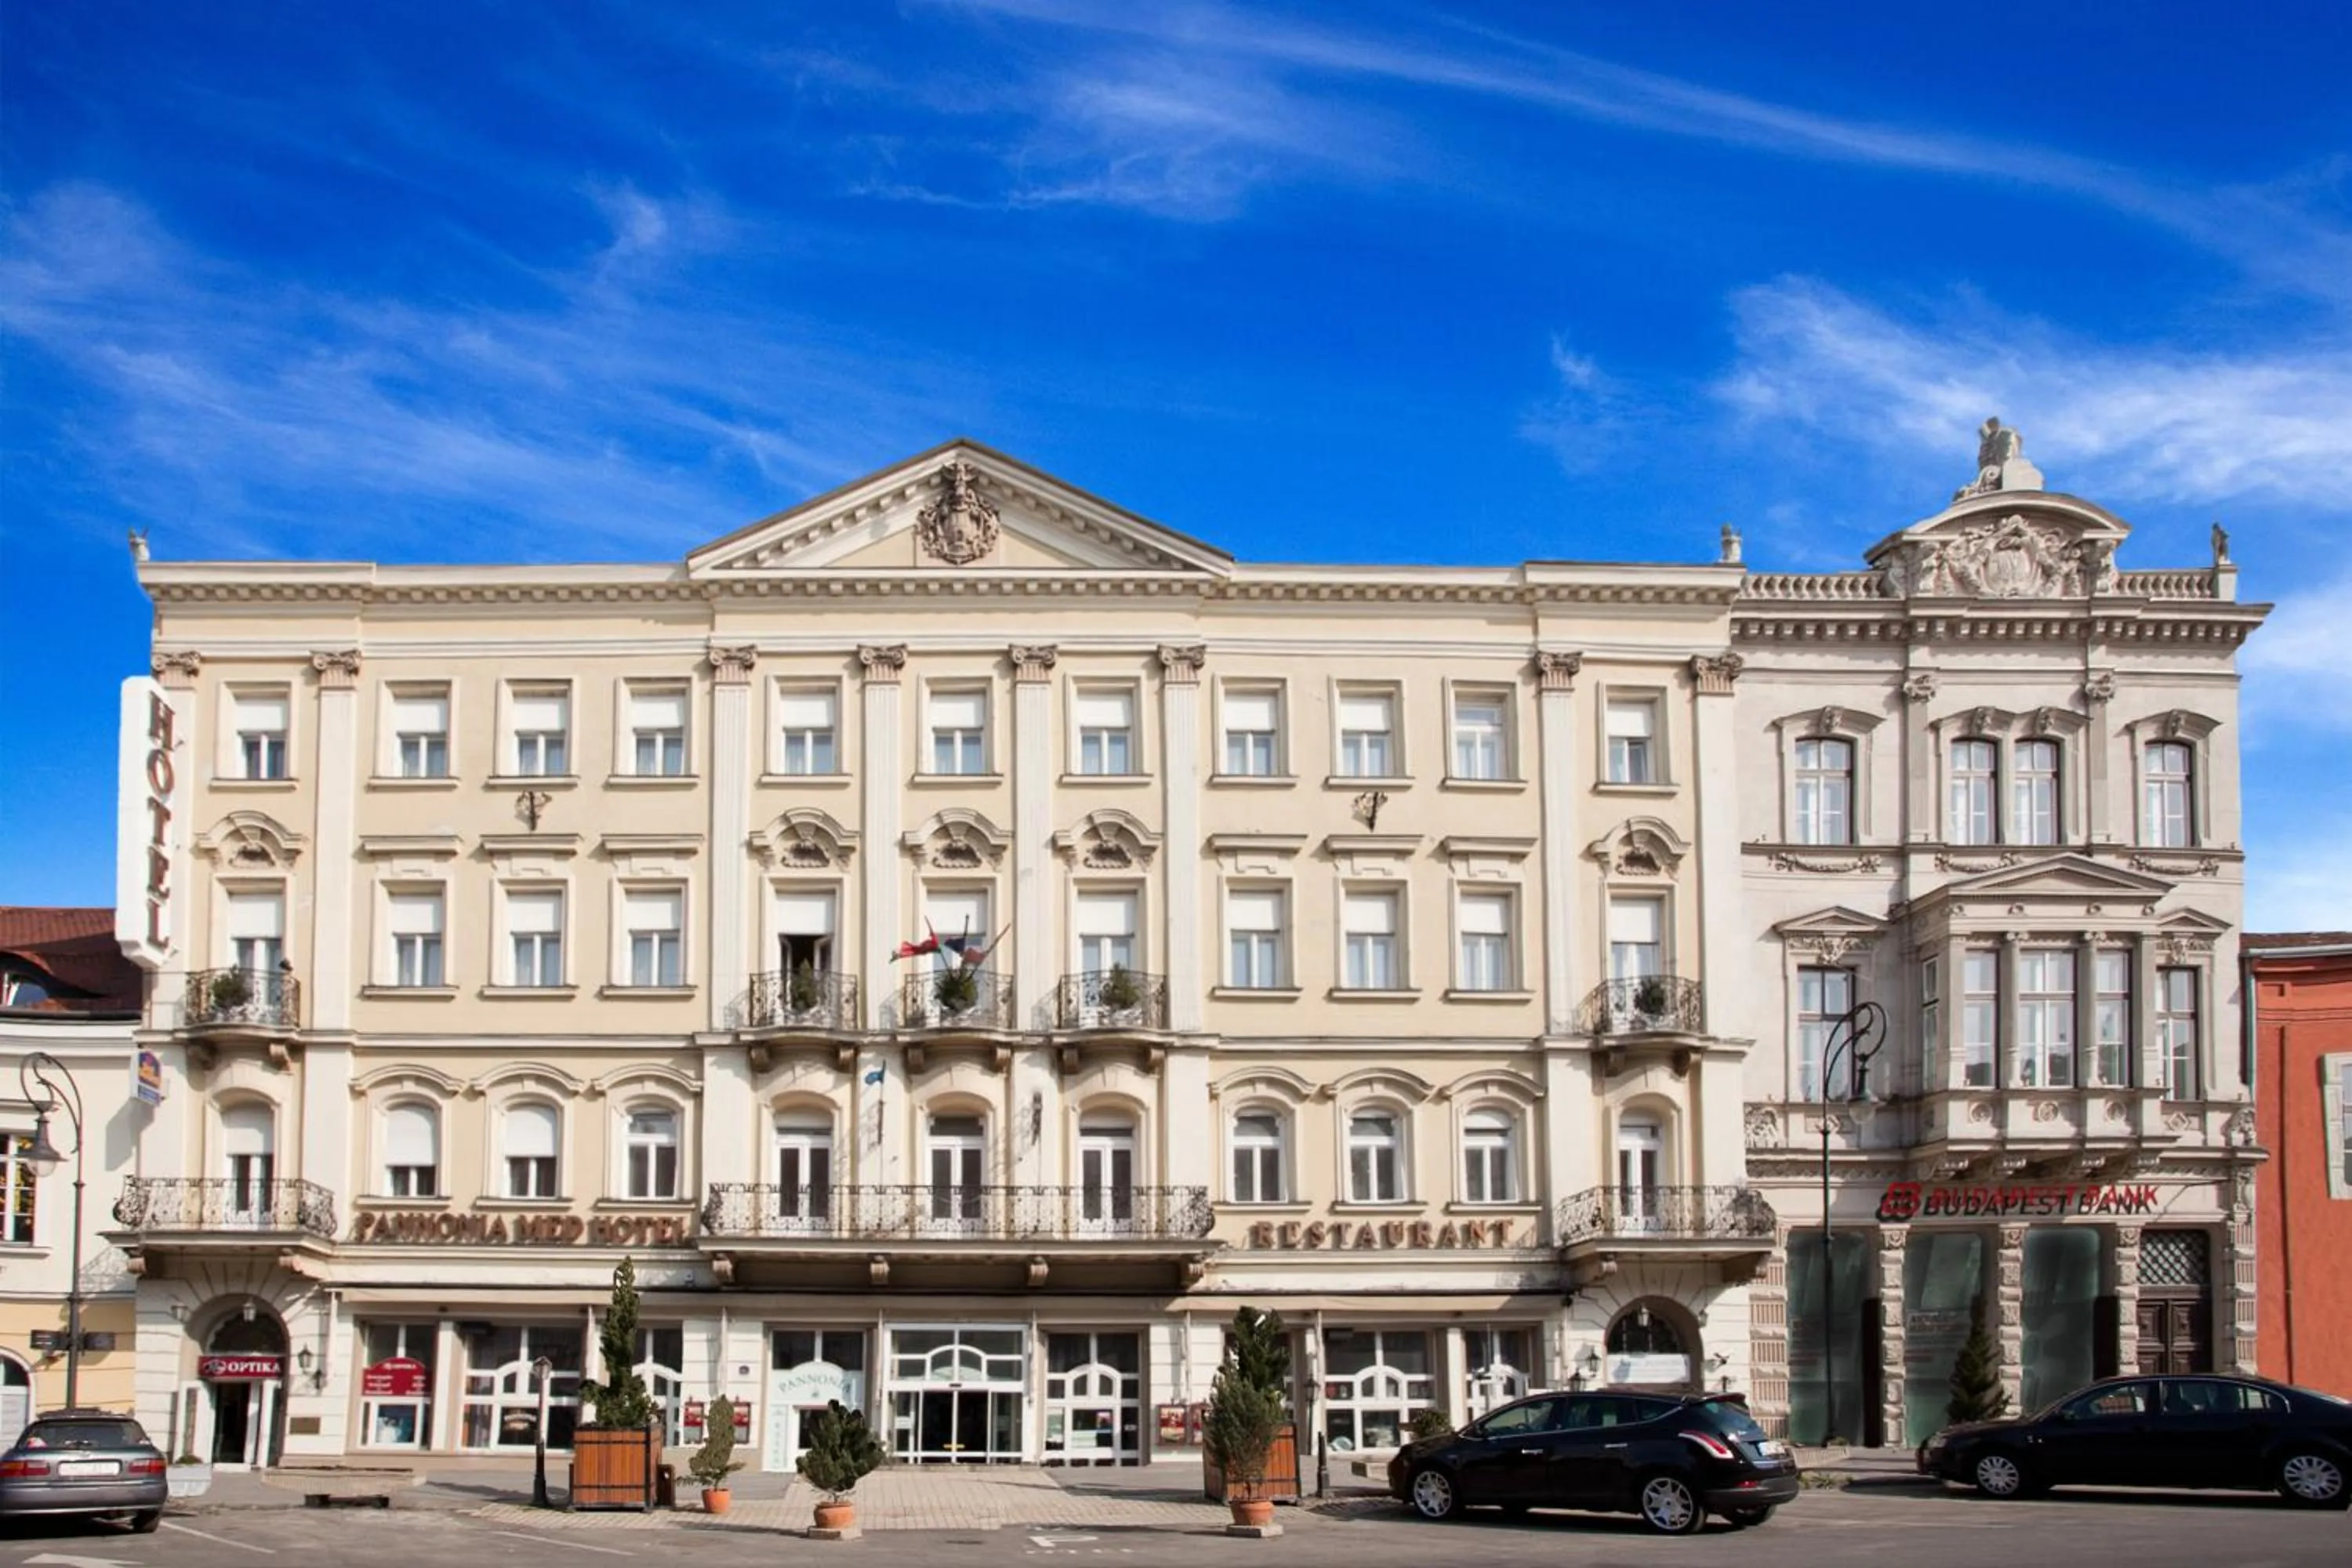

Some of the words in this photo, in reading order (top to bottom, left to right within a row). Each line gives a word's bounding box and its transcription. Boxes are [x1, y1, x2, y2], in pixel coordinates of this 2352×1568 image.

[147, 691, 175, 949] HOTEL
[1929, 1183, 2078, 1209] BUDAPEST
[2084, 1181, 2158, 1208] BANK
[358, 1211, 507, 1243] PANNONIA
[517, 1214, 584, 1243] MED
[592, 1215, 687, 1245] HOTEL
[1254, 1219, 1513, 1250] RESTAURANT
[227, 1360, 282, 1374] OPTIKA
